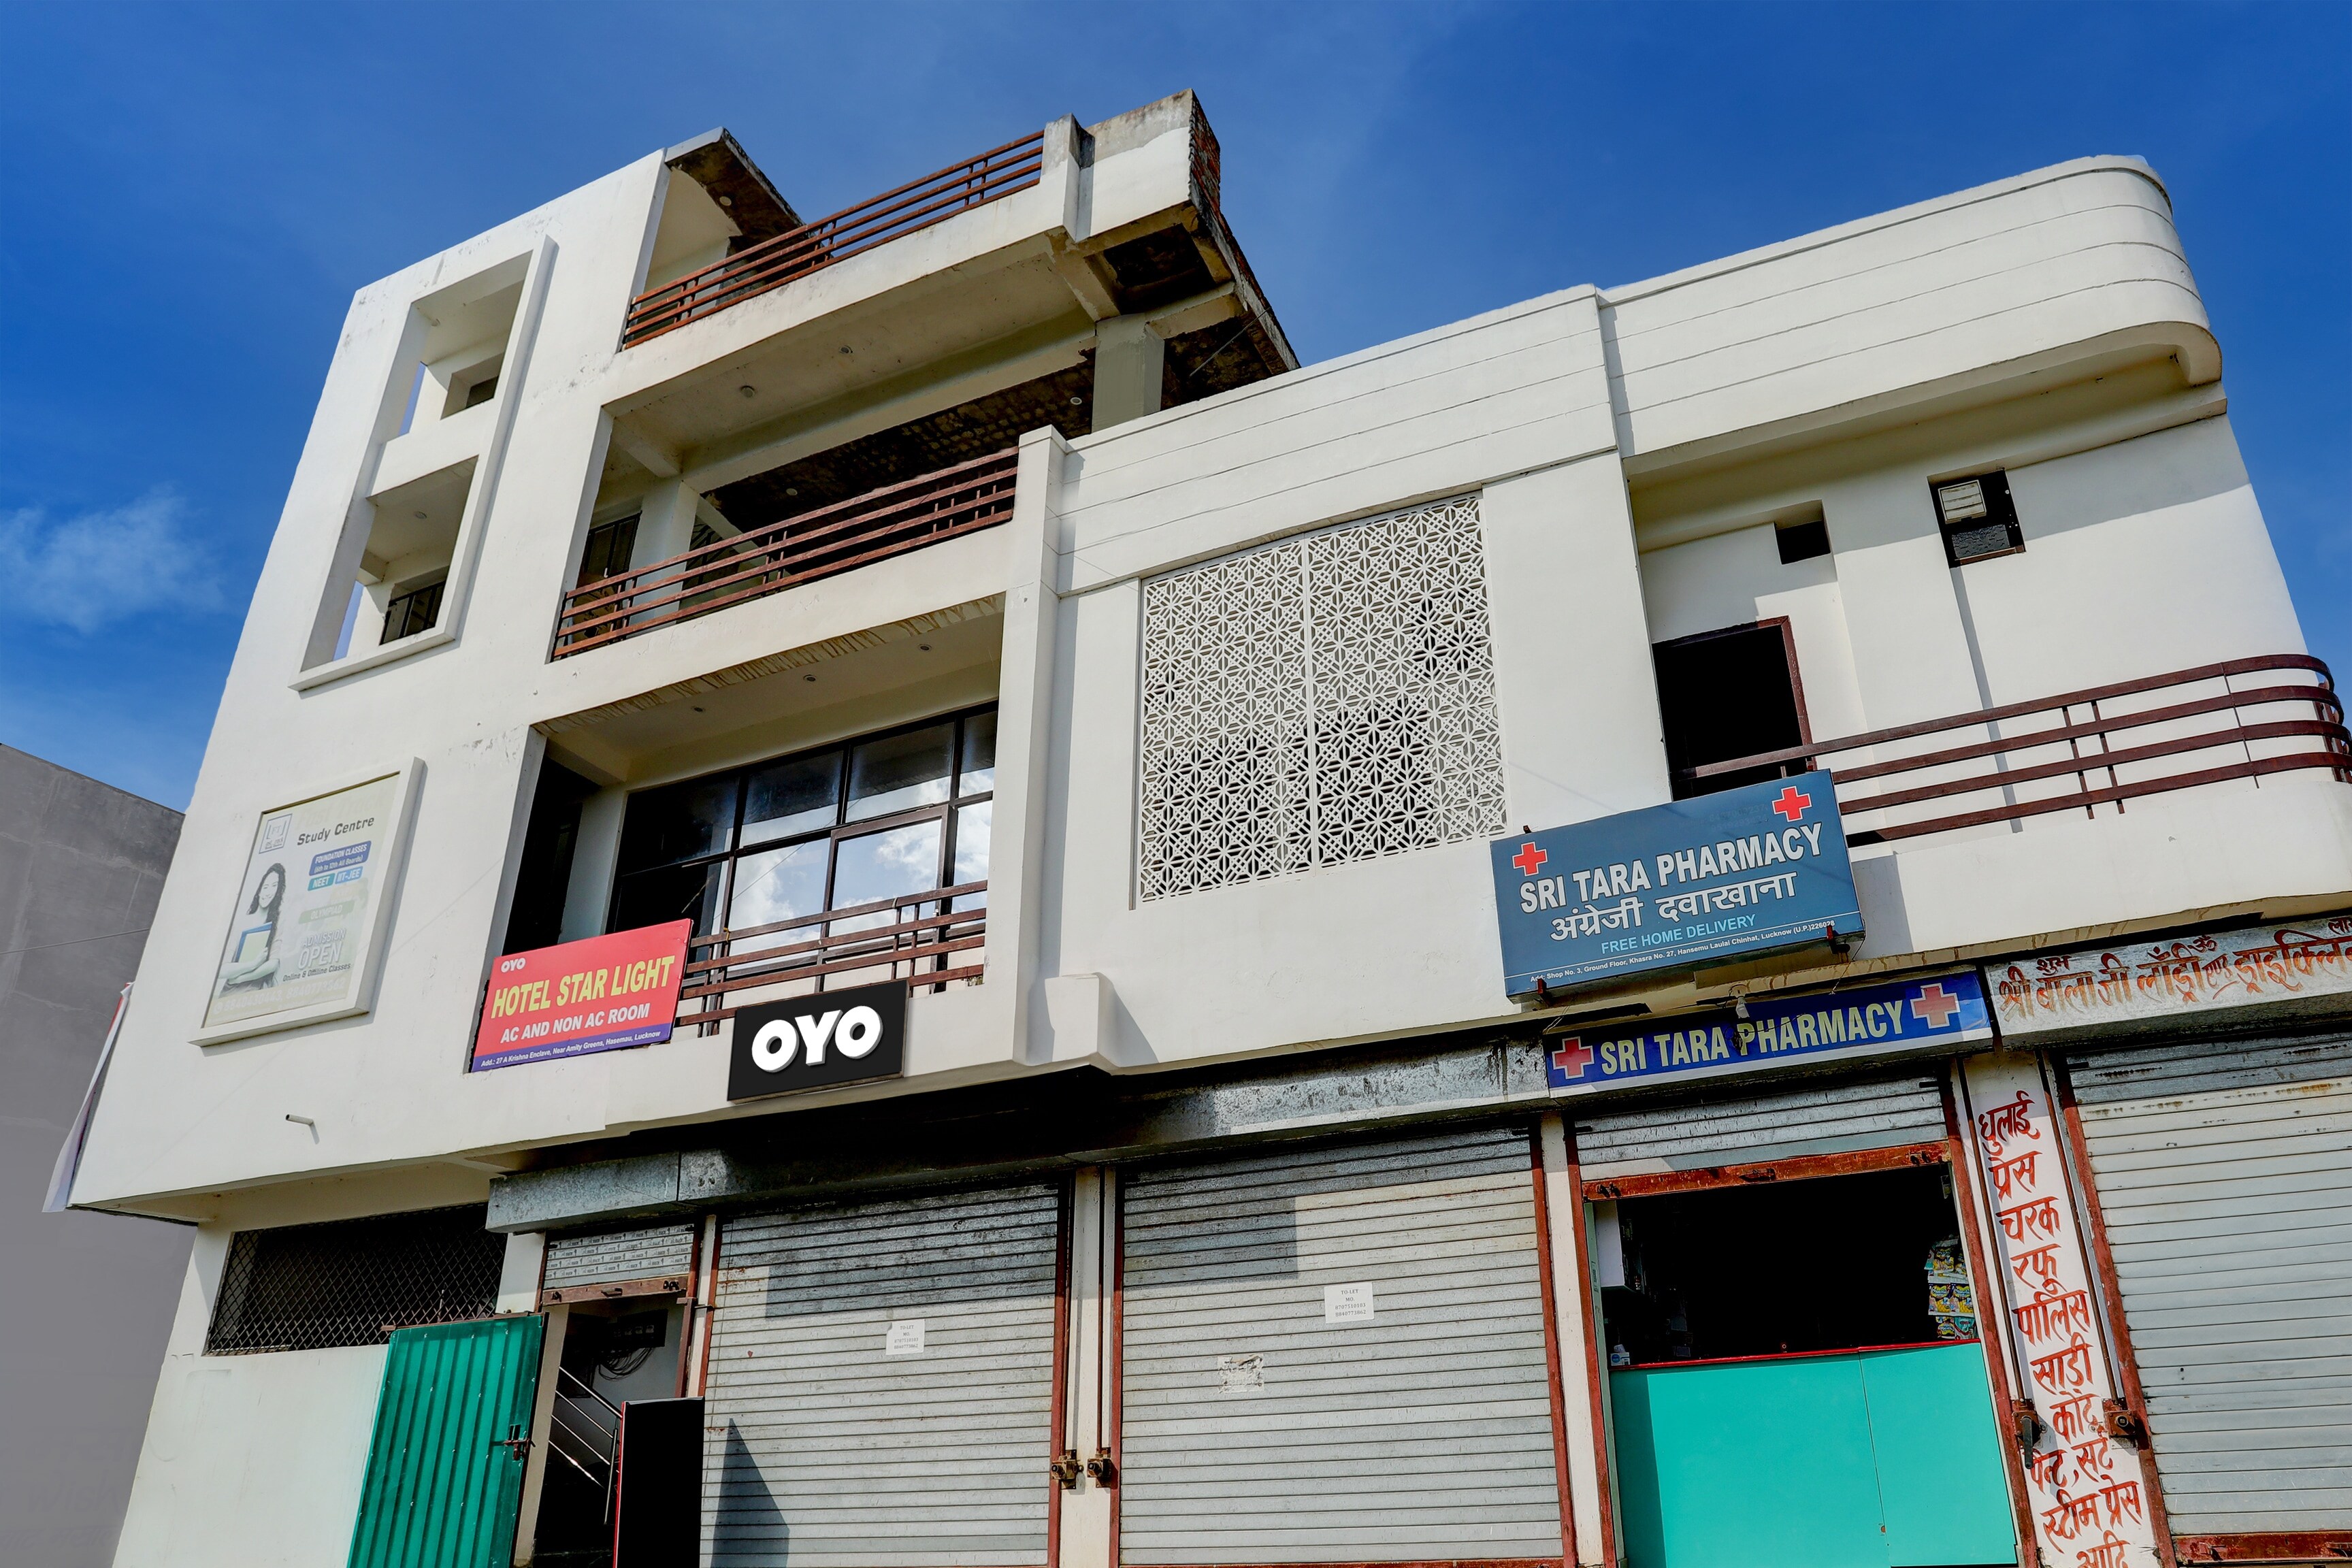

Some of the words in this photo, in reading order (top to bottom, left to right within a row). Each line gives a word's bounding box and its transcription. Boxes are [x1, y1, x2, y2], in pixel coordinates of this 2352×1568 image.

[297, 828, 331, 845] Study
[334, 817, 374, 836] Centre
[315, 849, 345, 864] FOUNDATION
[345, 844, 368, 856] CLASSES
[313, 876, 331, 888] NEET
[337, 868, 361, 883] IIT-JEE
[1520, 875, 1567, 914] SRI
[1573, 860, 1652, 904] TARA
[1656, 822, 1823, 887] PHARMACY
[310, 904, 343, 919] OLYMPIAD
[1550, 896, 1645, 942] अंग्रेजी
[1655, 872, 1798, 923] दवाखाना
[298, 940, 343, 970] OPEN
[302, 928, 346, 947] ADMISSION
[1546, 970, 1563, 980] Shop
[1565, 968, 1576, 976] No.
[1584, 962, 1608, 973] Ground
[1609, 958, 1629, 968] Floor,
[1629, 954, 1652, 965] Khasra
[1653, 951, 1665, 960] No.
[1667, 949, 1677, 958] 27,
[1677, 944, 1709, 956] Hansemu
[1732, 934, 1760, 945] Chinhat,
[1761, 929, 1792, 940] Lucknow
[1601, 936, 1638, 954] FREE
[1642, 928, 1683, 947] HOME
[1686, 913, 1756, 939] DELIVERY
[283, 973, 301, 982] Online
[329, 963, 351, 973] Classes
[490, 979, 551, 1019] HOTEL
[556, 968, 608, 1007] STAR
[610, 956, 676, 997] LIGHT
[501, 957, 526, 973] OYO
[2036, 954, 2072, 976] शुभ
[1999, 965, 2035, 1022] श्री
[500, 1026, 519, 1043] AC
[521, 1022, 550, 1040] AND
[552, 1015, 583, 1034] NON
[585, 1011, 605, 1029] AC
[607, 1003, 651, 1024] ROOM
[751, 1005, 883, 1073] OYO
[1600, 1038, 1648, 1077] SRI
[1654, 1025, 1730, 1067] TARA
[1737, 1000, 1904, 1057] PHARMACY
[495, 1057, 503, 1065] 27
[508, 1053, 529, 1062] Krishna
[529, 1049, 552, 1059] Enclave,
[552, 1047, 566, 1055] Near
[566, 1043, 583, 1054] Amity
[583, 1040, 604, 1049] Greens,
[605, 1035, 634, 1045] Hasemau,
[634, 1031, 662, 1041] Lucknow
[1978, 1090, 2040, 1156] धुलाई
[1988, 1151, 2042, 1203] प्रेस
[1995, 1196, 2061, 1244] चरक
[2010, 1243, 2067, 1292] रफू
[2012, 1290, 2091, 1347] पालिस
[2099, 1474, 2142, 1529] प्रेस
